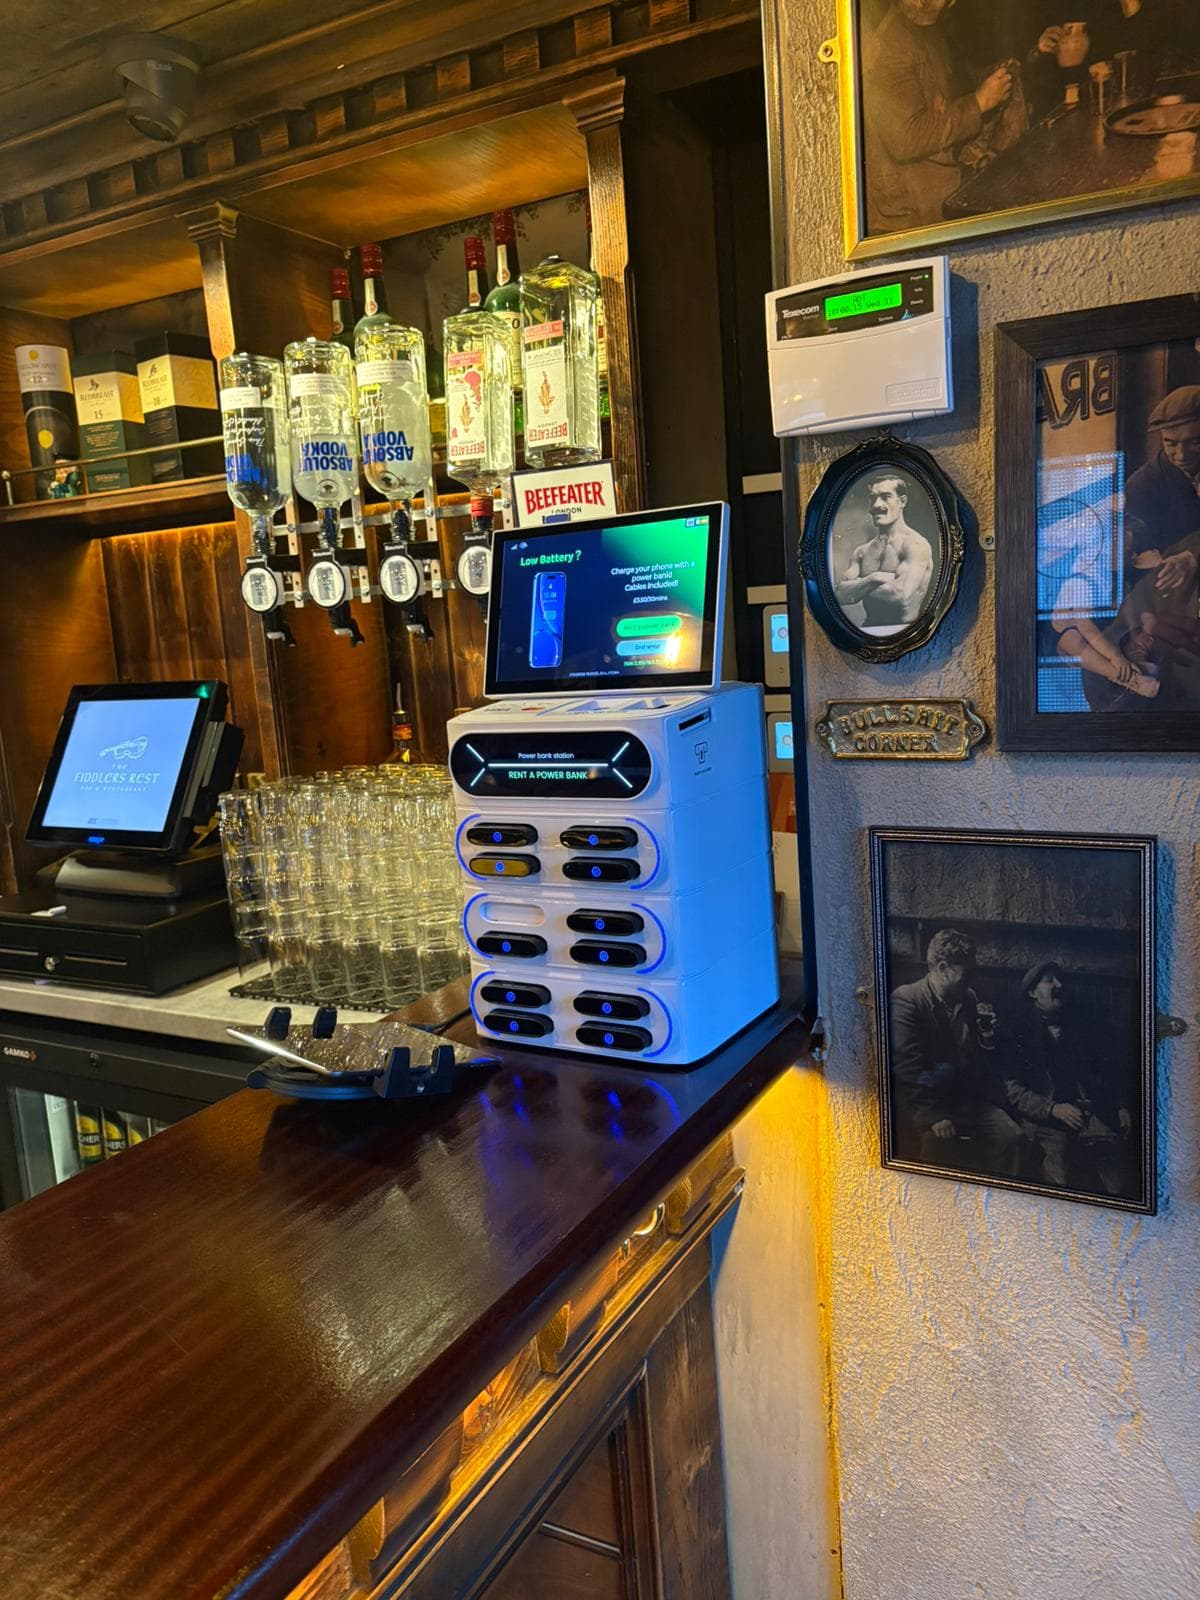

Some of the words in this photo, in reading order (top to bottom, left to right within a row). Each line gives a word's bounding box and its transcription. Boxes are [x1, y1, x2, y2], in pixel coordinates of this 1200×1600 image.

[782, 305, 820, 318] Texecom
[94, 409, 104, 420] 15
[528, 422, 568, 442] BEEFEATER
[302, 441, 348, 457] VODKA
[450, 441, 485, 457] BEEFEATER
[524, 481, 605, 515] BEEFEATER
[520, 556, 538, 566] Low
[540, 552, 574, 564] Battery
[611, 568, 634, 576] Charge
[635, 564, 650, 574] your
[651, 562, 673, 573] phone
[674, 560, 690, 569] with
[631, 573, 652, 583] power
[624, 582, 646, 592] Cables
[838, 704, 959, 736] BULLSHIT
[854, 732, 939, 752] CORNER
[74, 771, 126, 784] FIDDLERS
[128, 772, 160, 784] REST
[508, 771, 527, 779] RENT
[529, 771, 535, 779] A
[536, 771, 564, 779] POWER
[566, 771, 588, 779] BANK
